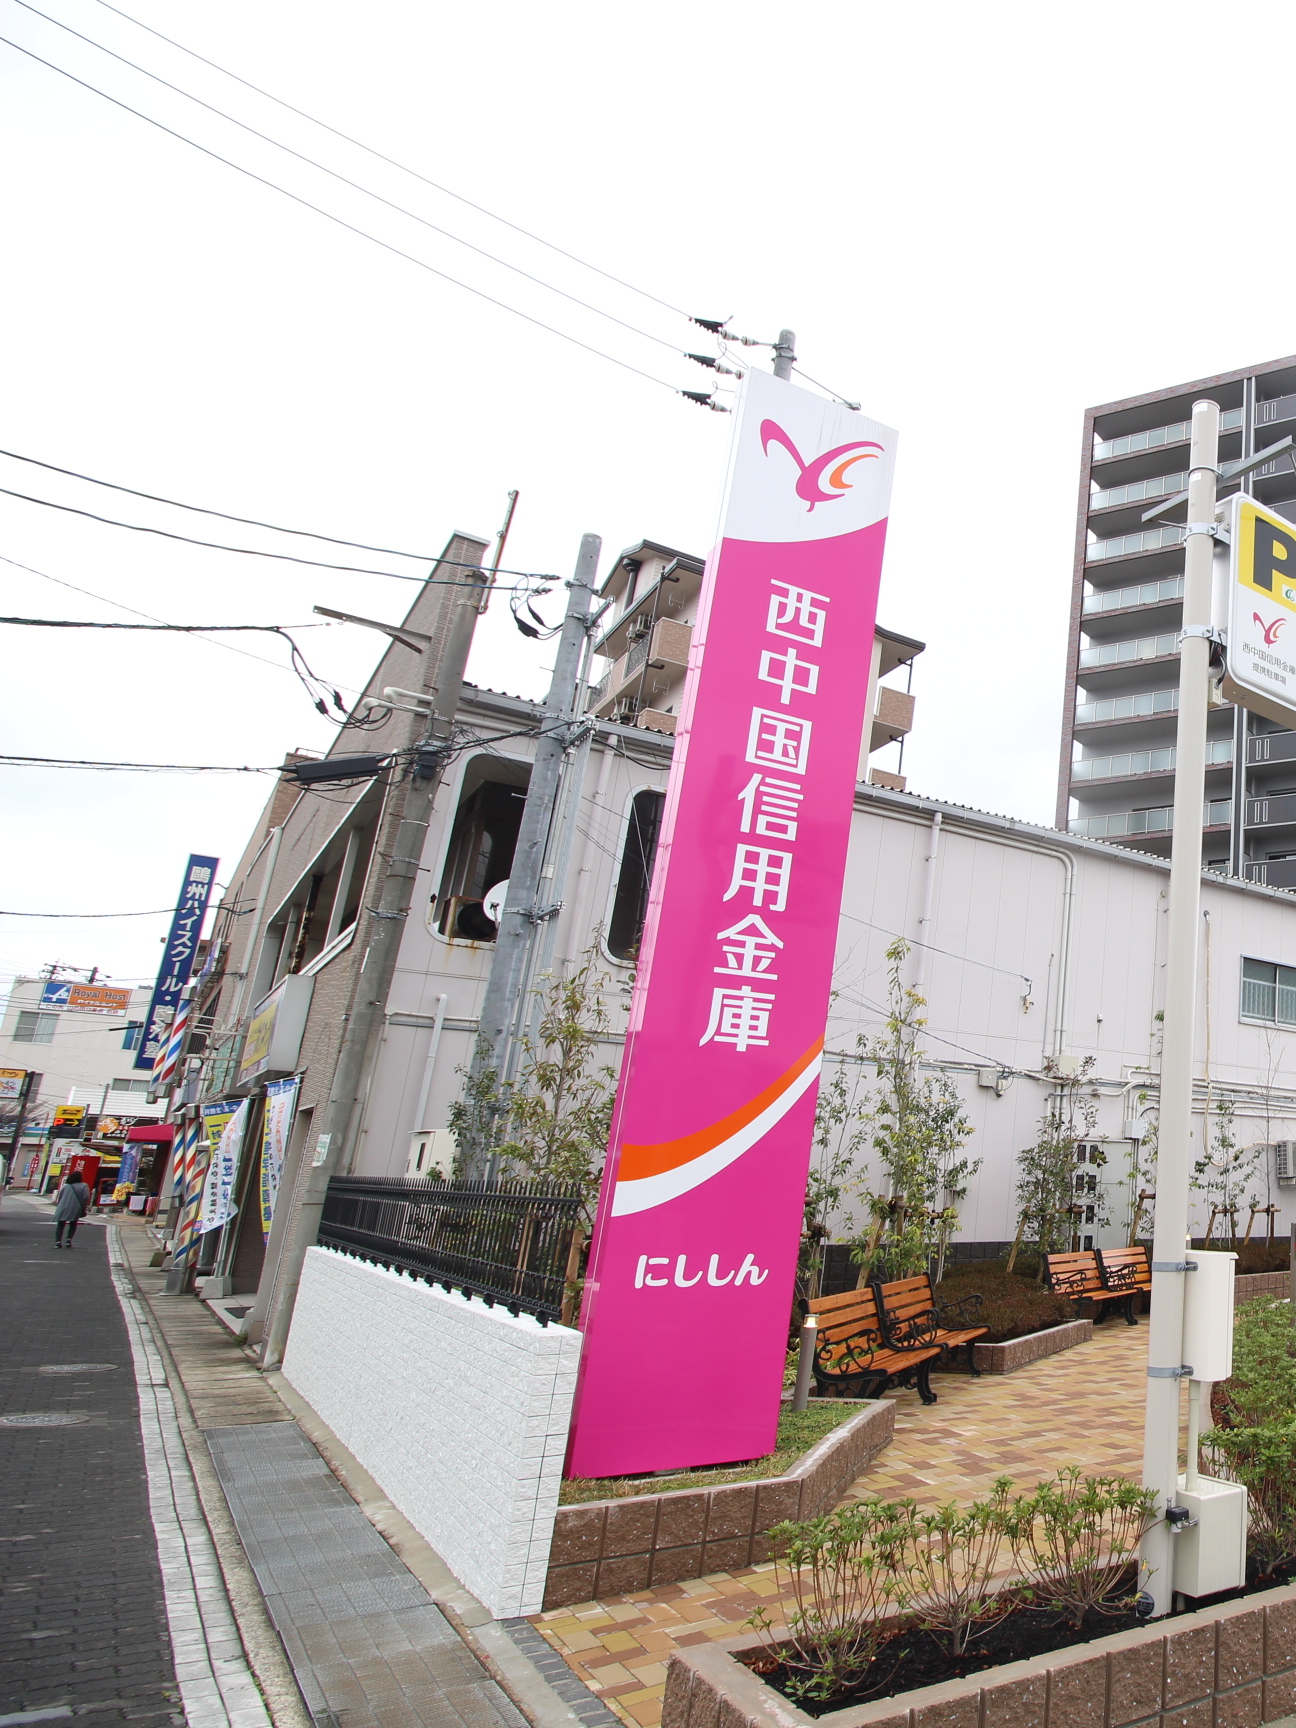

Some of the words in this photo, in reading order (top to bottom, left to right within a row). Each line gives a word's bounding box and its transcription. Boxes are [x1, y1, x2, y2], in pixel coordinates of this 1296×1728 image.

[1242, 642, 1296, 677] 西中国信用金庫
[1251, 662, 1288, 687] 提携駐車場
[699, 578, 831, 1053] 西中国信用金庫
[73, 988, 101, 999] Royal
[104, 991, 128, 1001] Host
[634, 1253, 769, 1290] にししん
